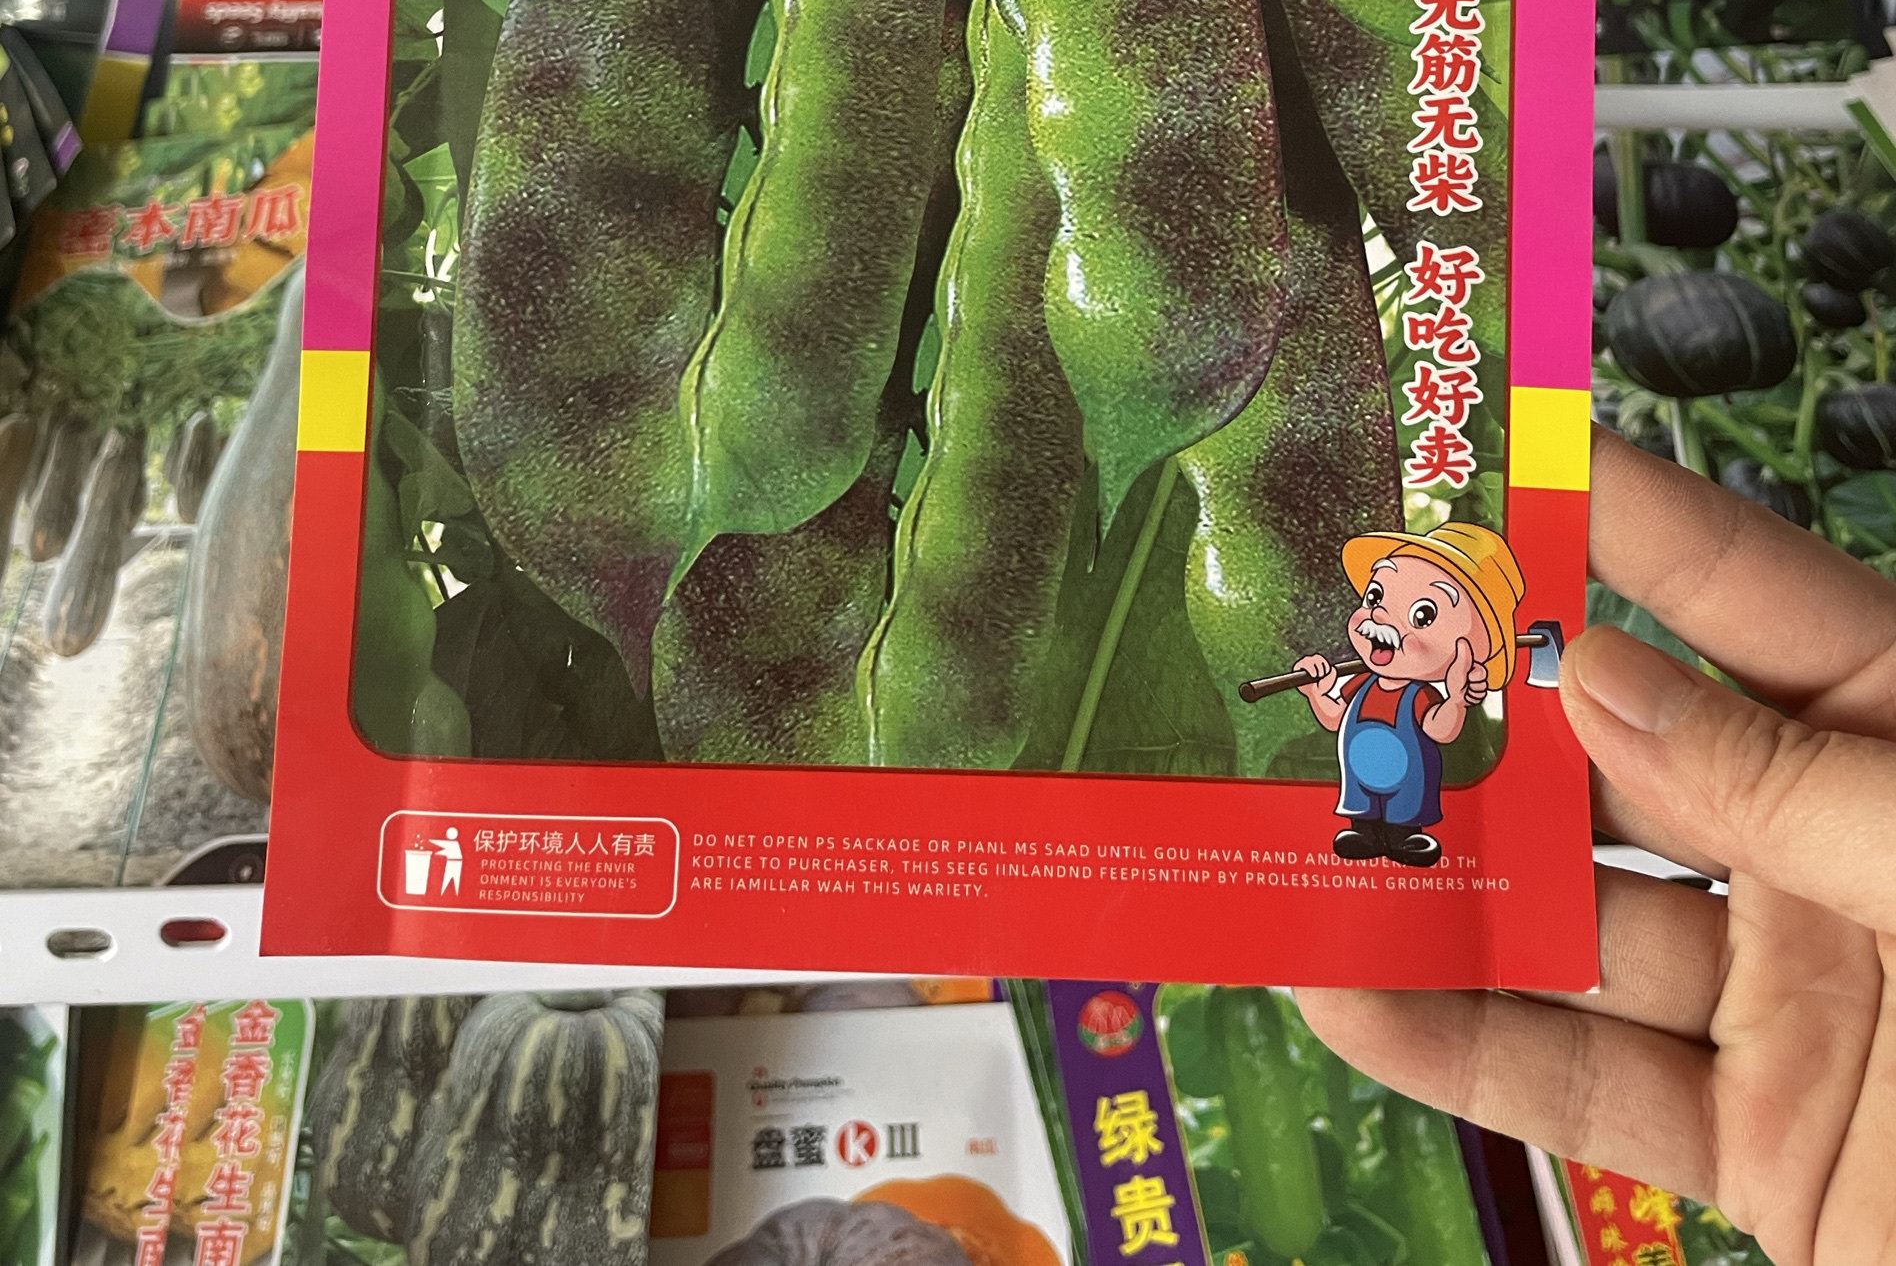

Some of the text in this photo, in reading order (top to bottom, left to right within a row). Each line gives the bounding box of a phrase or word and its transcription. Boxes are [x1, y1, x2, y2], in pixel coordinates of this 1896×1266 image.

[1401, 240, 1484, 490] 好吃好卖
[473, 829, 656, 857] 保护环境人人有责
[693, 834, 717, 847] DO
[724, 835, 756, 848] NET
[763, 835, 808, 849] OPEN
[816, 836, 835, 850] PS
[842, 837, 921, 852] SACKAOE
[928, 839, 950, 852] OR
[957, 840, 1008, 854] PIANL
[1015, 842, 1037, 855] MS
[1044, 843, 1090, 857] SAAD
[1097, 845, 1147, 860] UNTIL
[1154, 846, 1190, 861] GOU
[1198, 848, 1244, 863] HAVA
[1251, 850, 1298, 864] RAND
[1457, 855, 1476, 868] TH
[481, 858, 635, 873] PROTECTING THE ENVIR
[692, 855, 753, 869] KOTICE
[760, 856, 781, 869] TO
[788, 857, 895, 874] PURCHASER,
[902, 860, 940, 874] THIS
[947, 861, 989, 876] SEEG
[1100, 866, 1211, 883] FEEPISNTINP
[1218, 870, 1238, 884] BY
[1385, 876, 1465, 891] GROMERS
[1471, 878, 1510, 891] WHO
[480, 874, 637, 889] ONMENT IS EVERYONE'S
[690, 877, 989, 898] ARE IAMILLAR WAH THIS WARIETY.
[479, 889, 585, 903] RESPONSIBILITY
[1092, 1089, 1186, 1266] 绿贵
